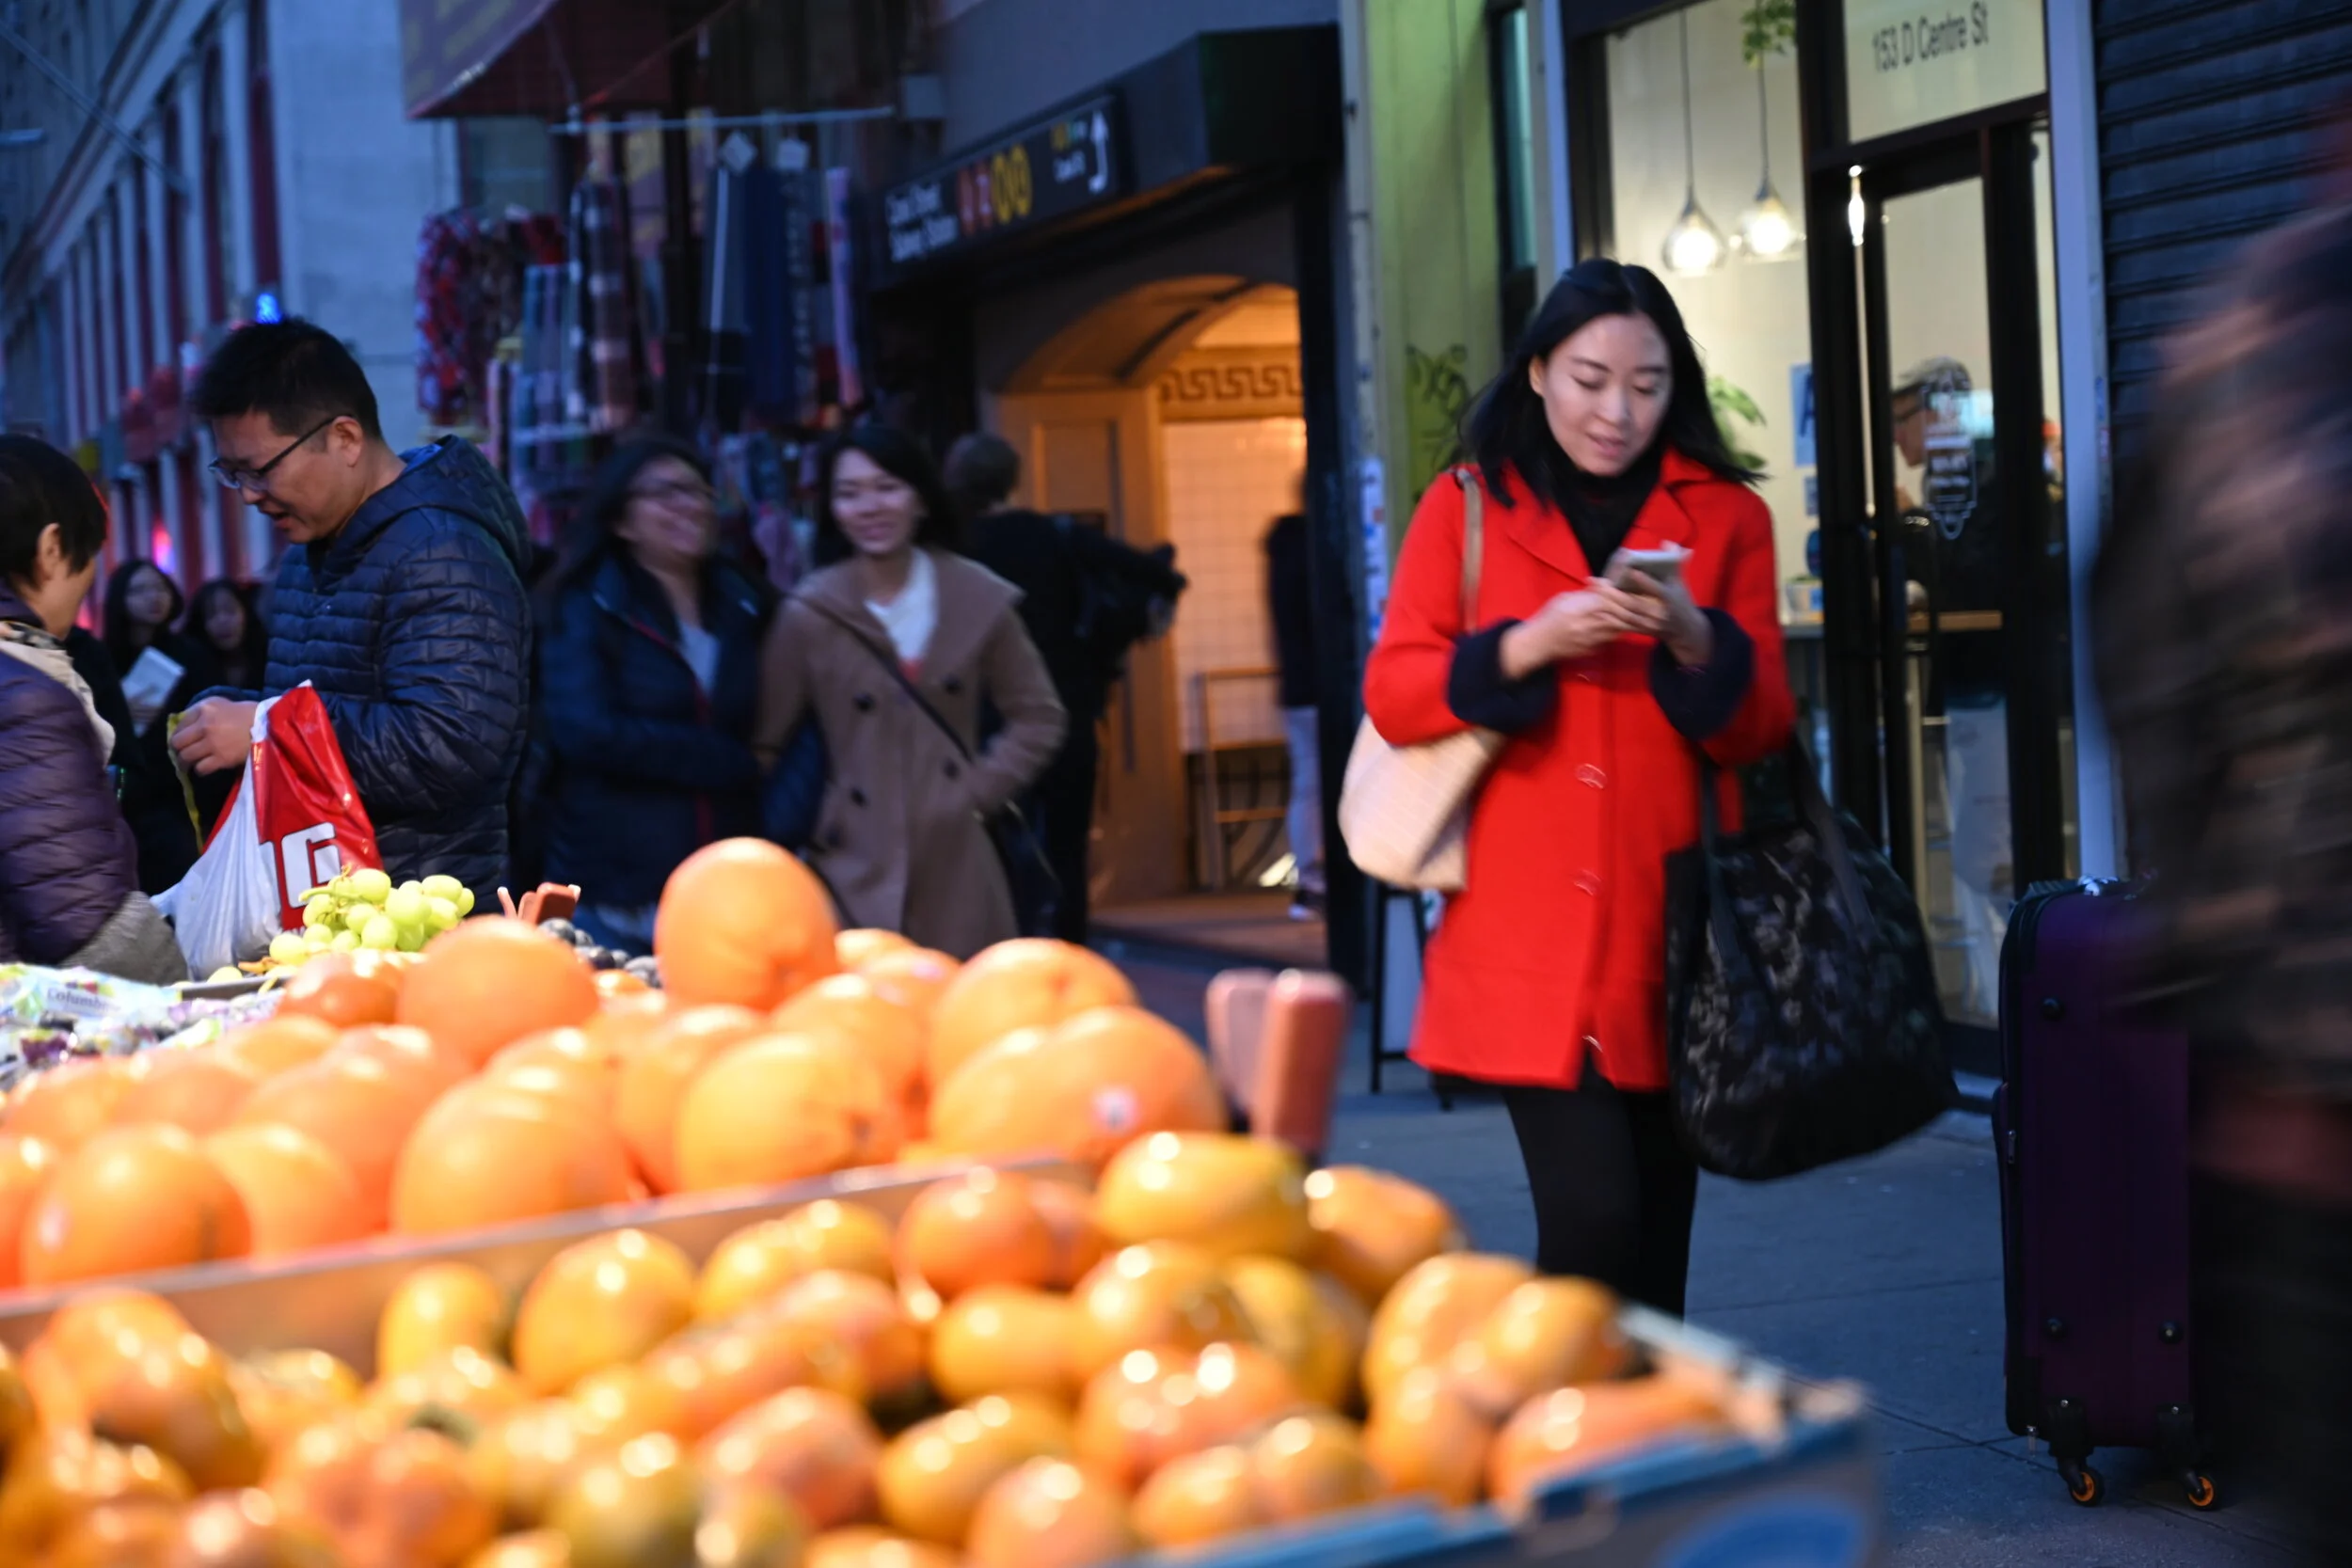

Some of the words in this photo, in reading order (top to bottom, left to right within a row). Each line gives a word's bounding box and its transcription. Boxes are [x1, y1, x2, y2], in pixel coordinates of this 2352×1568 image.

[1872, 24, 1899, 71] 153
[1901, 19, 1915, 66] D
[1917, 10, 1968, 61] Centre
[1970, 0, 1989, 46] St
